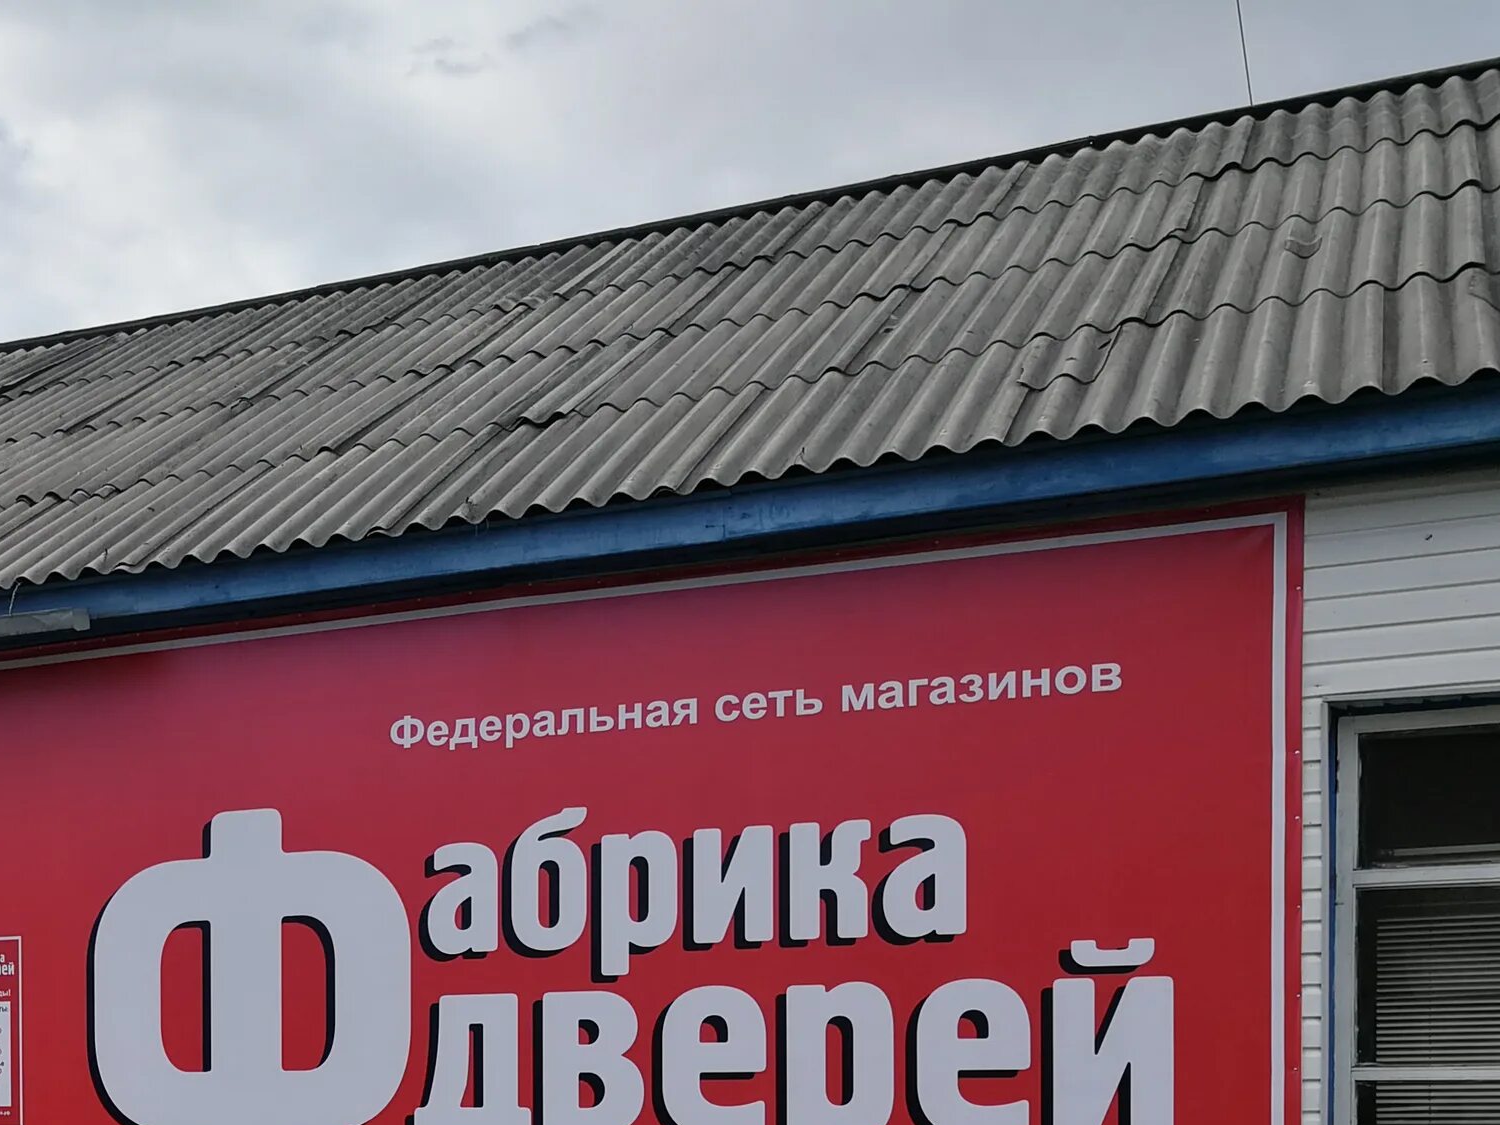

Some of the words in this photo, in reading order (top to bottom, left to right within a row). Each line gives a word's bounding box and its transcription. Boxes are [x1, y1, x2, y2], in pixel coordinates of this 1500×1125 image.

[388, 693, 700, 751] Федеральная
[713, 686, 825, 724] сеть
[840, 655, 1124, 713] магазинов
